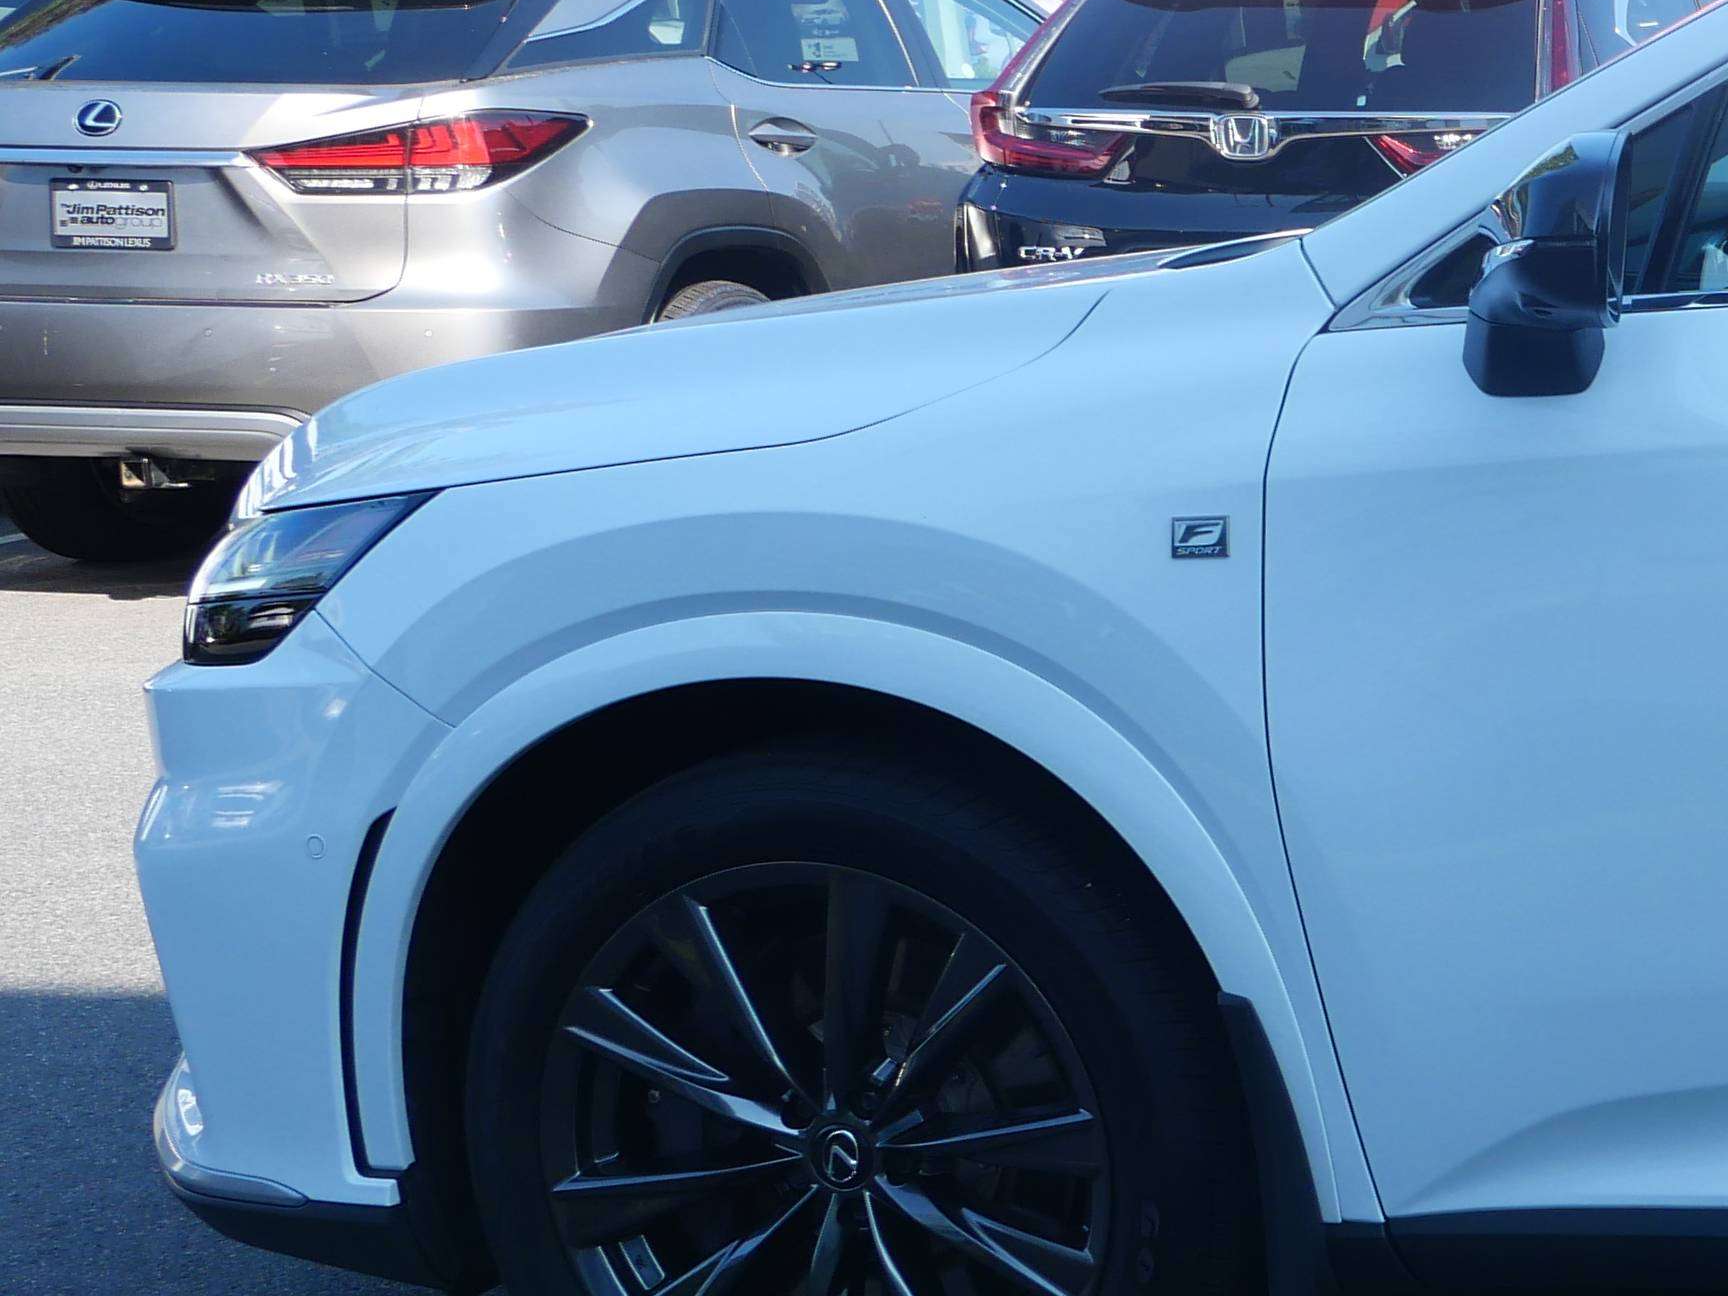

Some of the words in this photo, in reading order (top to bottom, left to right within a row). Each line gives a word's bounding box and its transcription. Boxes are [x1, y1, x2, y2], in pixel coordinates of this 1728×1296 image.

[85, 237, 124, 246] PATTISON
[124, 238, 151, 247] LEXUS
[1019, 246, 1085, 262] CR-V
[1176, 546, 1221, 555] SPORT
